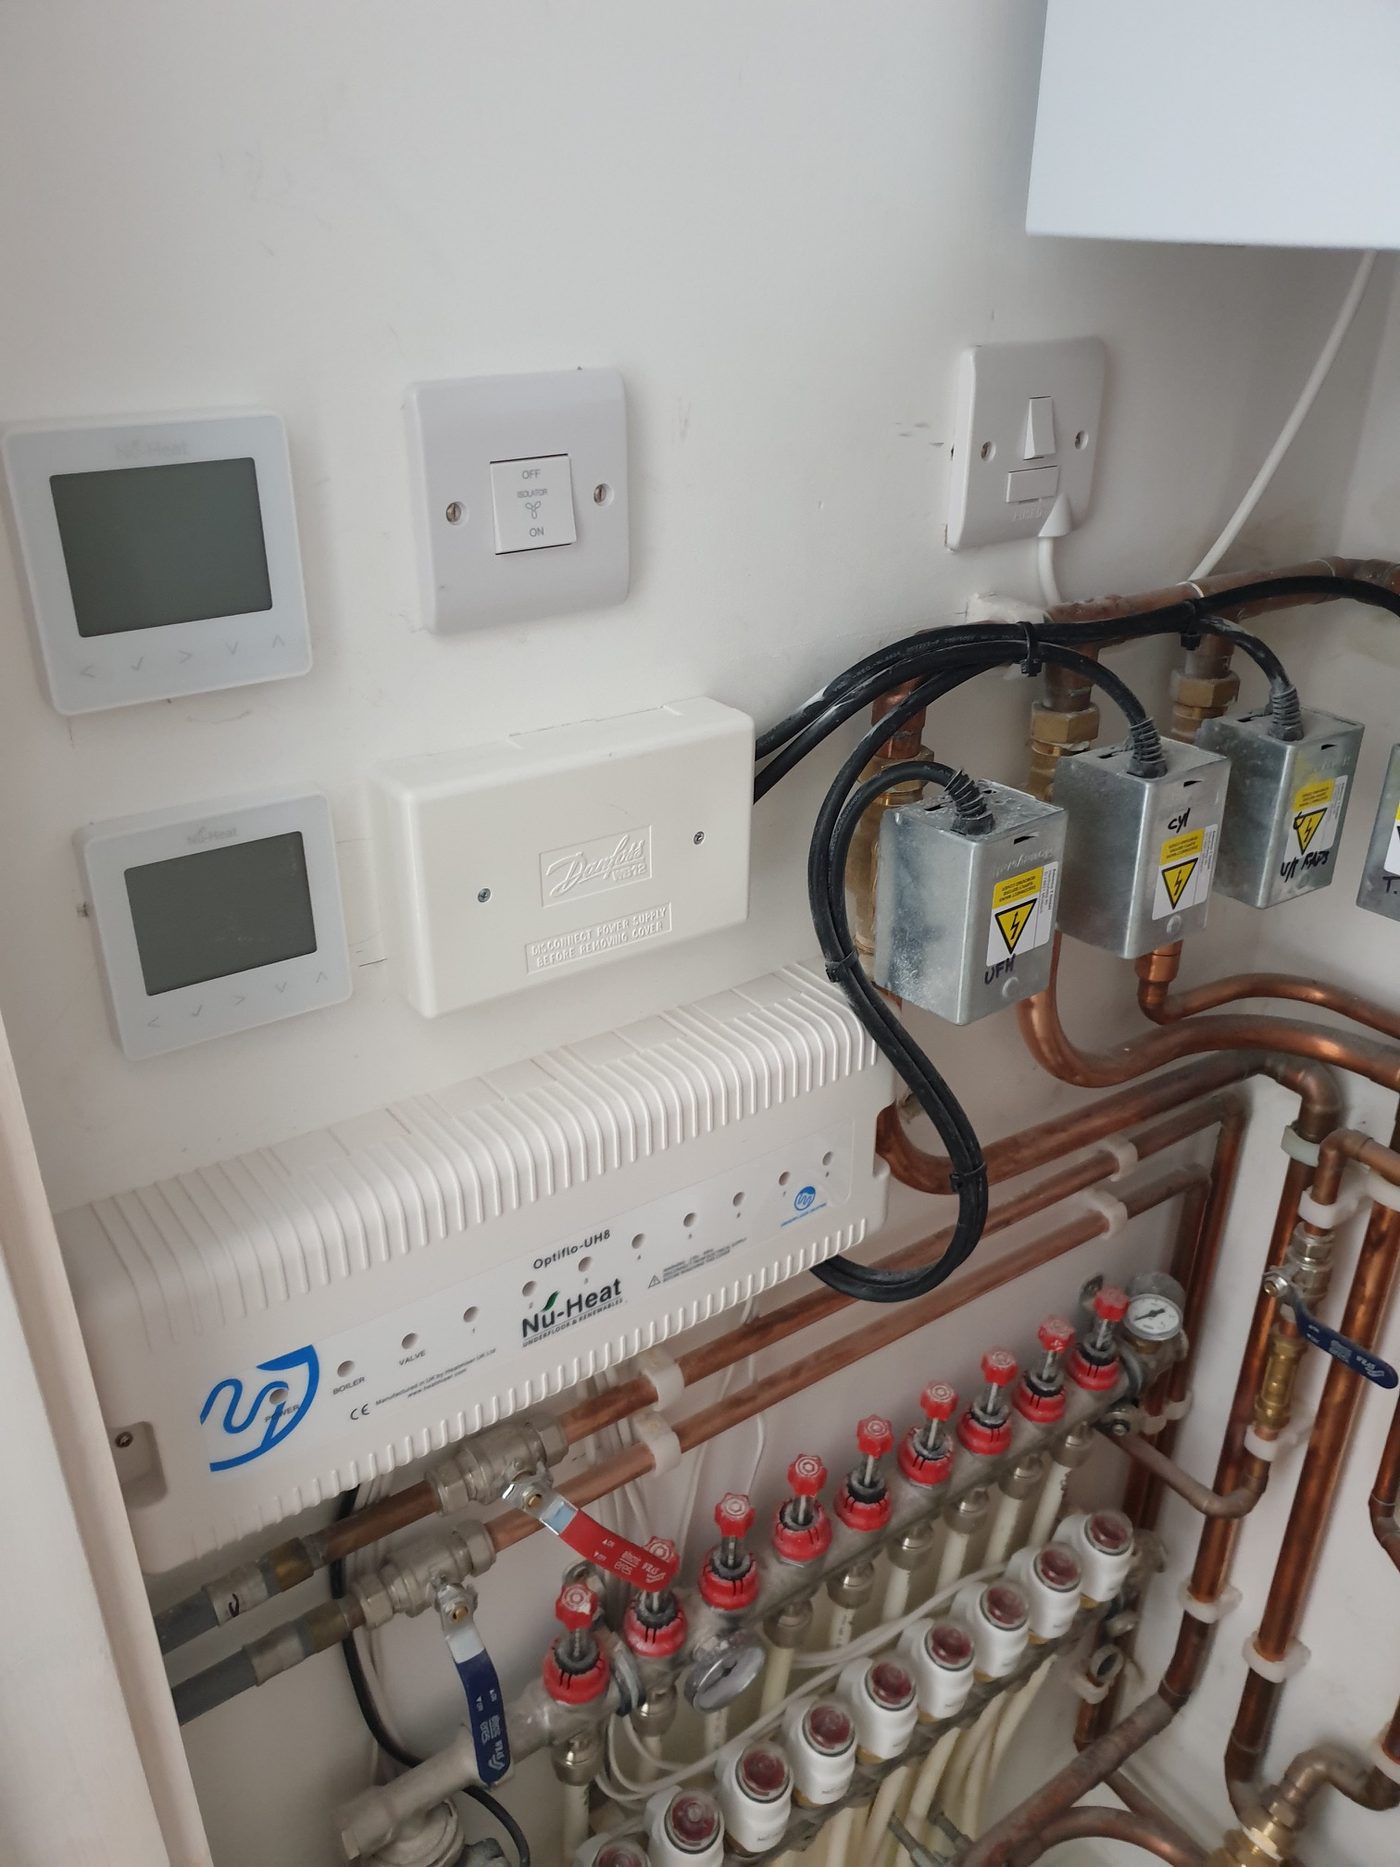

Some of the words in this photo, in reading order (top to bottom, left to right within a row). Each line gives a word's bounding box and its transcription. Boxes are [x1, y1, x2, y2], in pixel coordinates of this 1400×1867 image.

[516, 488, 548, 499] ISOLATOR
[521, 468, 541, 480] OFF
[528, 526, 545, 538] ON
[545, 834, 645, 897] Danfoss
[530, 930, 593, 957] DISCONNECT
[596, 919, 630, 938] POWER
[632, 906, 668, 927] SUPPLY
[536, 948, 576, 969] BEFORE
[579, 932, 629, 956] REMOVING
[631, 920, 664, 939] COVER
[532, 1228, 611, 1270] Optiflo-UH8
[521, 1277, 622, 1338] Nu-Heat
[522, 1323, 570, 1348] UNDERFLOOR
[578, 1298, 624, 1322] RENEWABLES
[398, 1349, 426, 1366] VALVE
[332, 1376, 366, 1396] BOILER
